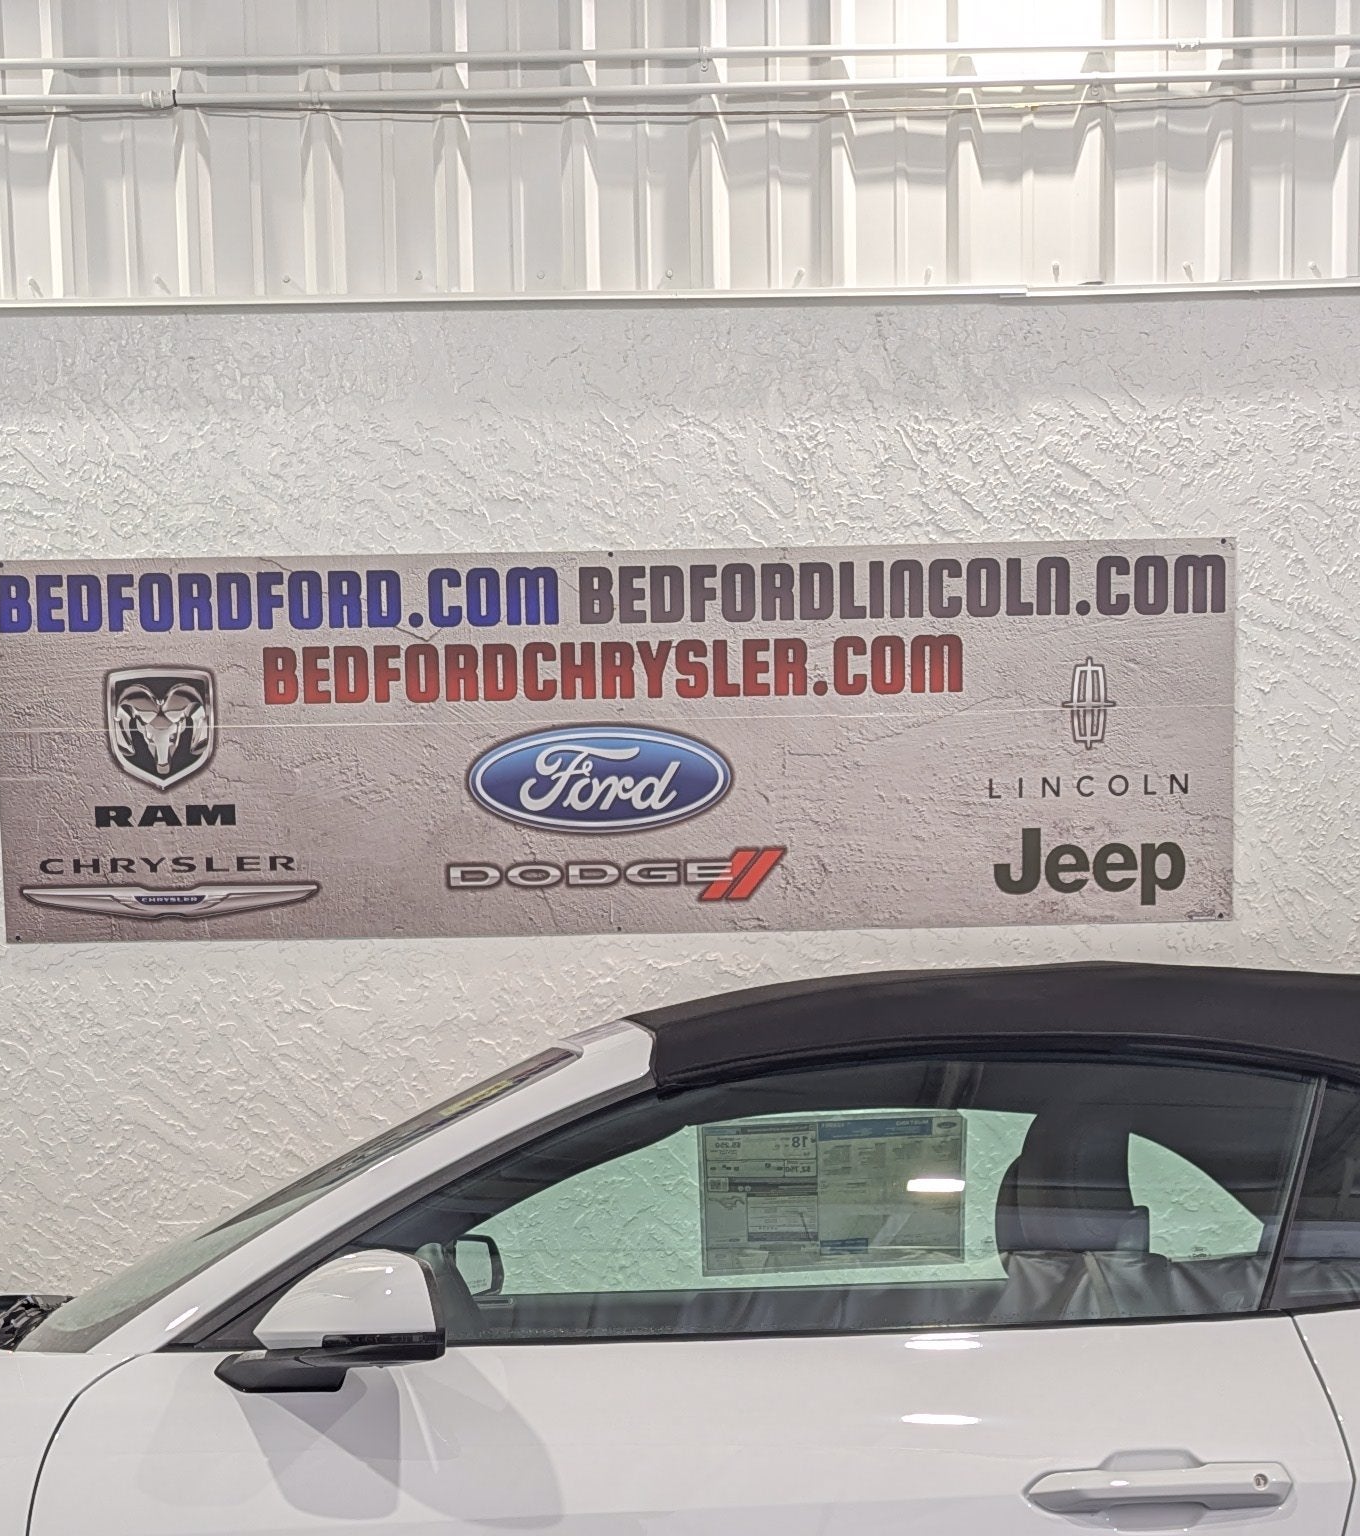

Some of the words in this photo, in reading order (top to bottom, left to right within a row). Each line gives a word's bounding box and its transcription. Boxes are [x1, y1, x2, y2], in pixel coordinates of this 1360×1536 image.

[578, 555, 1226, 625] BEDFORDLINCOLN.COM
[263, 634, 963, 705] BEDFORDCHRYSLER.COM
[520, 744, 681, 812] Ford
[989, 773, 1189, 798] LINCOLN
[95, 803, 236, 828] RAM
[40, 856, 296, 874] CHRYSLER
[448, 861, 734, 888] DODGE
[993, 828, 1186, 906] Jeep
